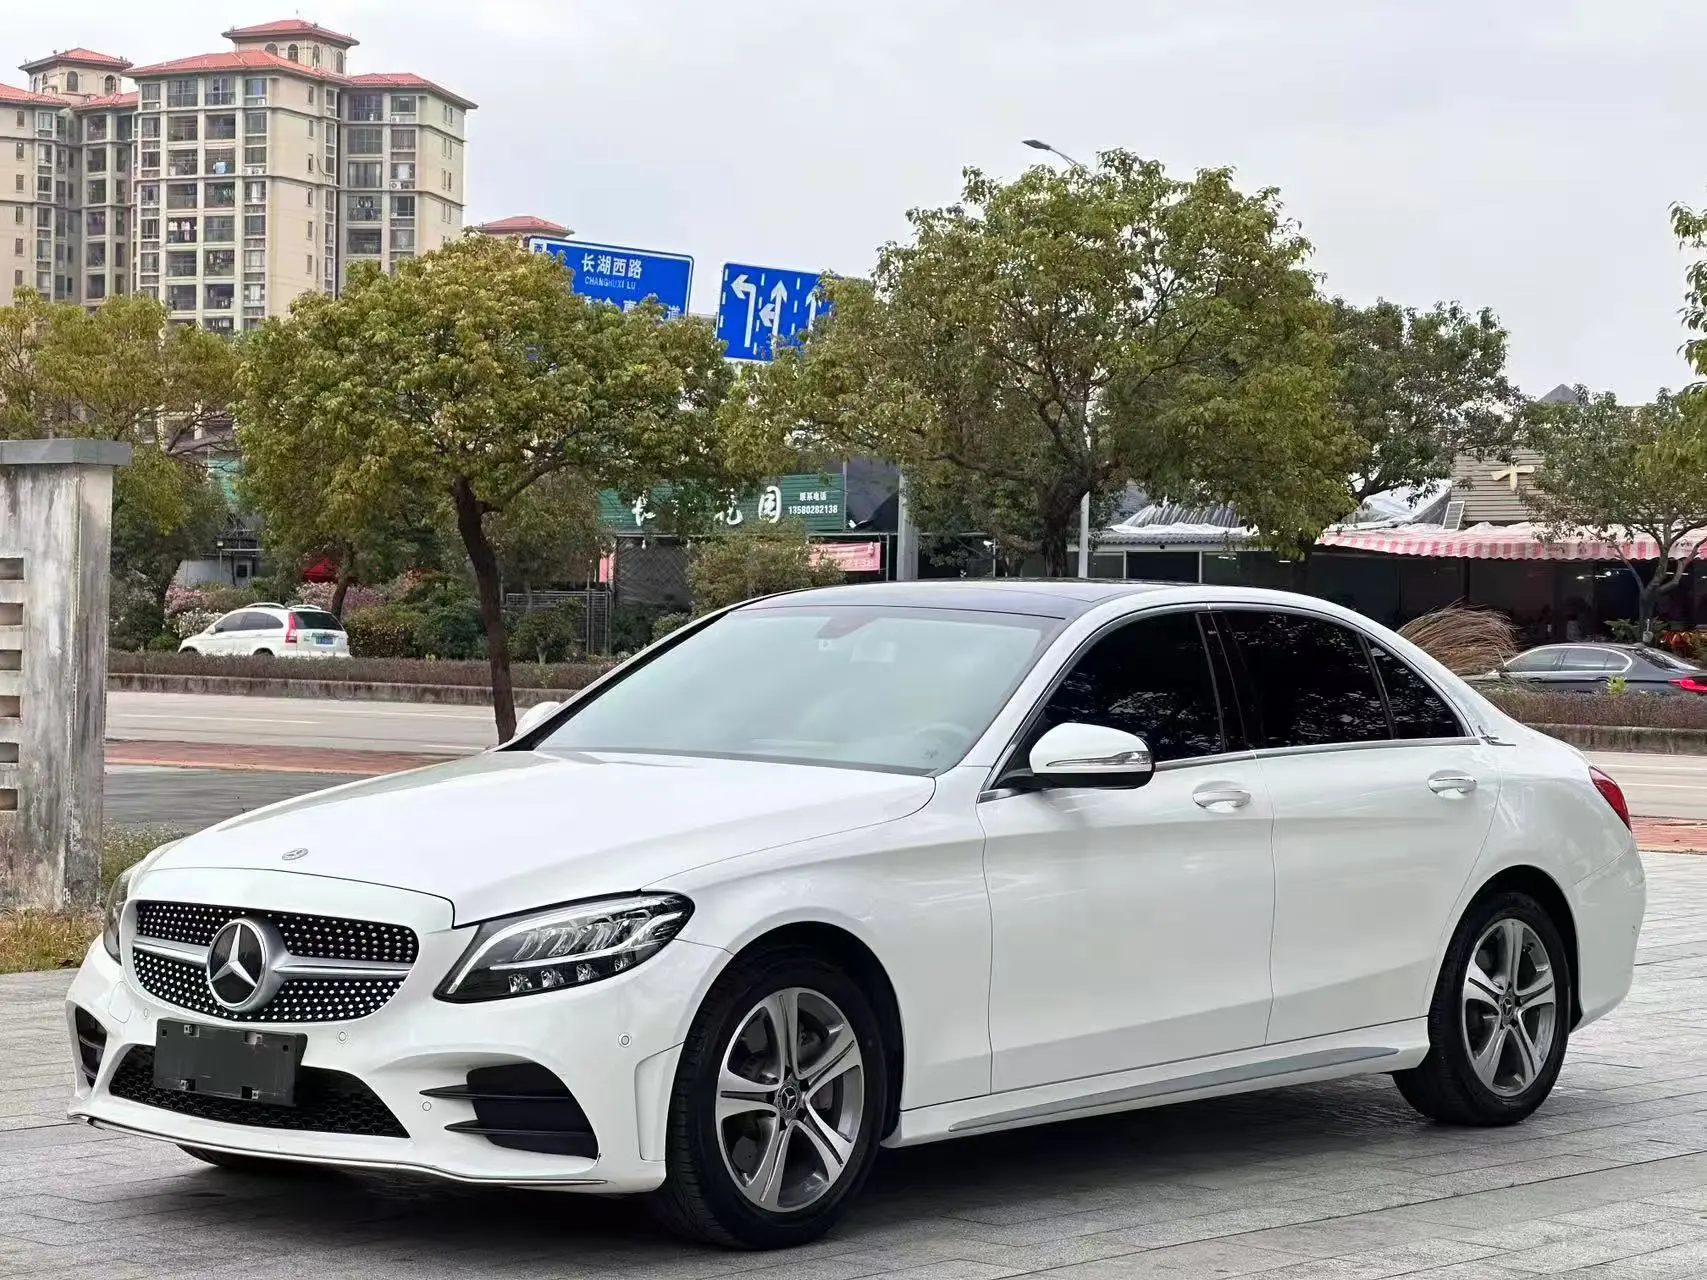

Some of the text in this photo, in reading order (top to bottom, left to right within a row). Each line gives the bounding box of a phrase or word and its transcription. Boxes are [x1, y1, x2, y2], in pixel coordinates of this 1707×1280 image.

[581, 253, 642, 279] 长湖西路
[584, 276, 636, 290] CHANGHUXI LU
[788, 504, 838, 515] 13580282138
